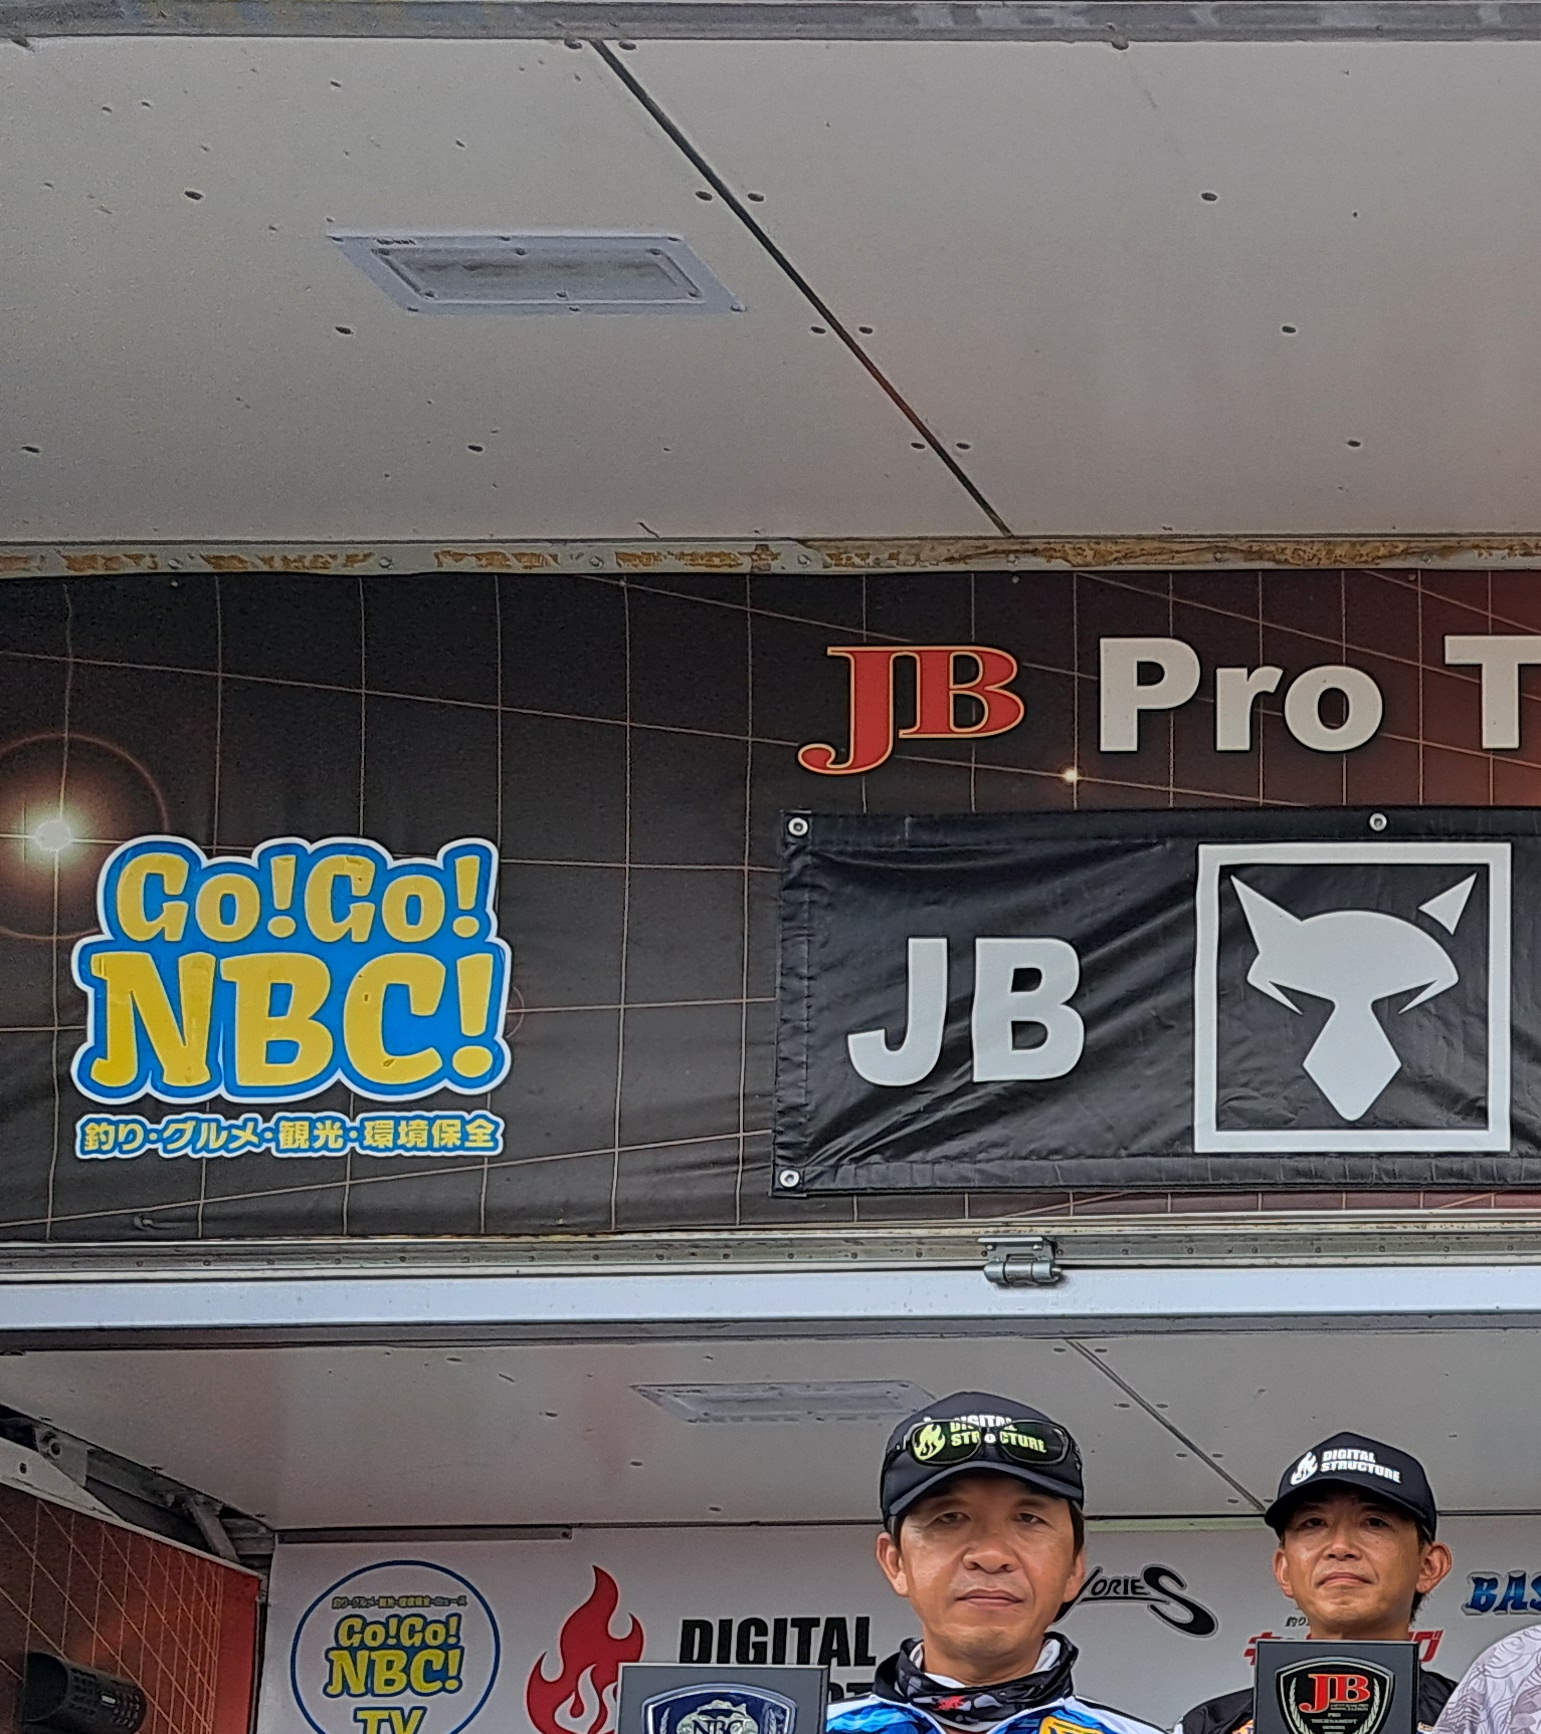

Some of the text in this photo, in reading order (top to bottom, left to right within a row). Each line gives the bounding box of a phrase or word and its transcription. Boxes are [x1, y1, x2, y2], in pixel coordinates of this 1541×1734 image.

[798, 645, 1024, 774] JB
[1099, 636, 1385, 754] Pro
[116, 852, 480, 944] Go!Go!
[90, 950, 493, 1089] NBC!
[846, 936, 1086, 1088] JB
[1319, 1460, 1402, 1484] STRUCTURE
[1321, 1448, 1377, 1463] DIGITAL
[337, 1615, 461, 1648] Go!Go!
[679, 1616, 878, 1667] DIGITAL
[326, 1647, 463, 1696] NBC!
[1298, 1672, 1371, 1714] JB
